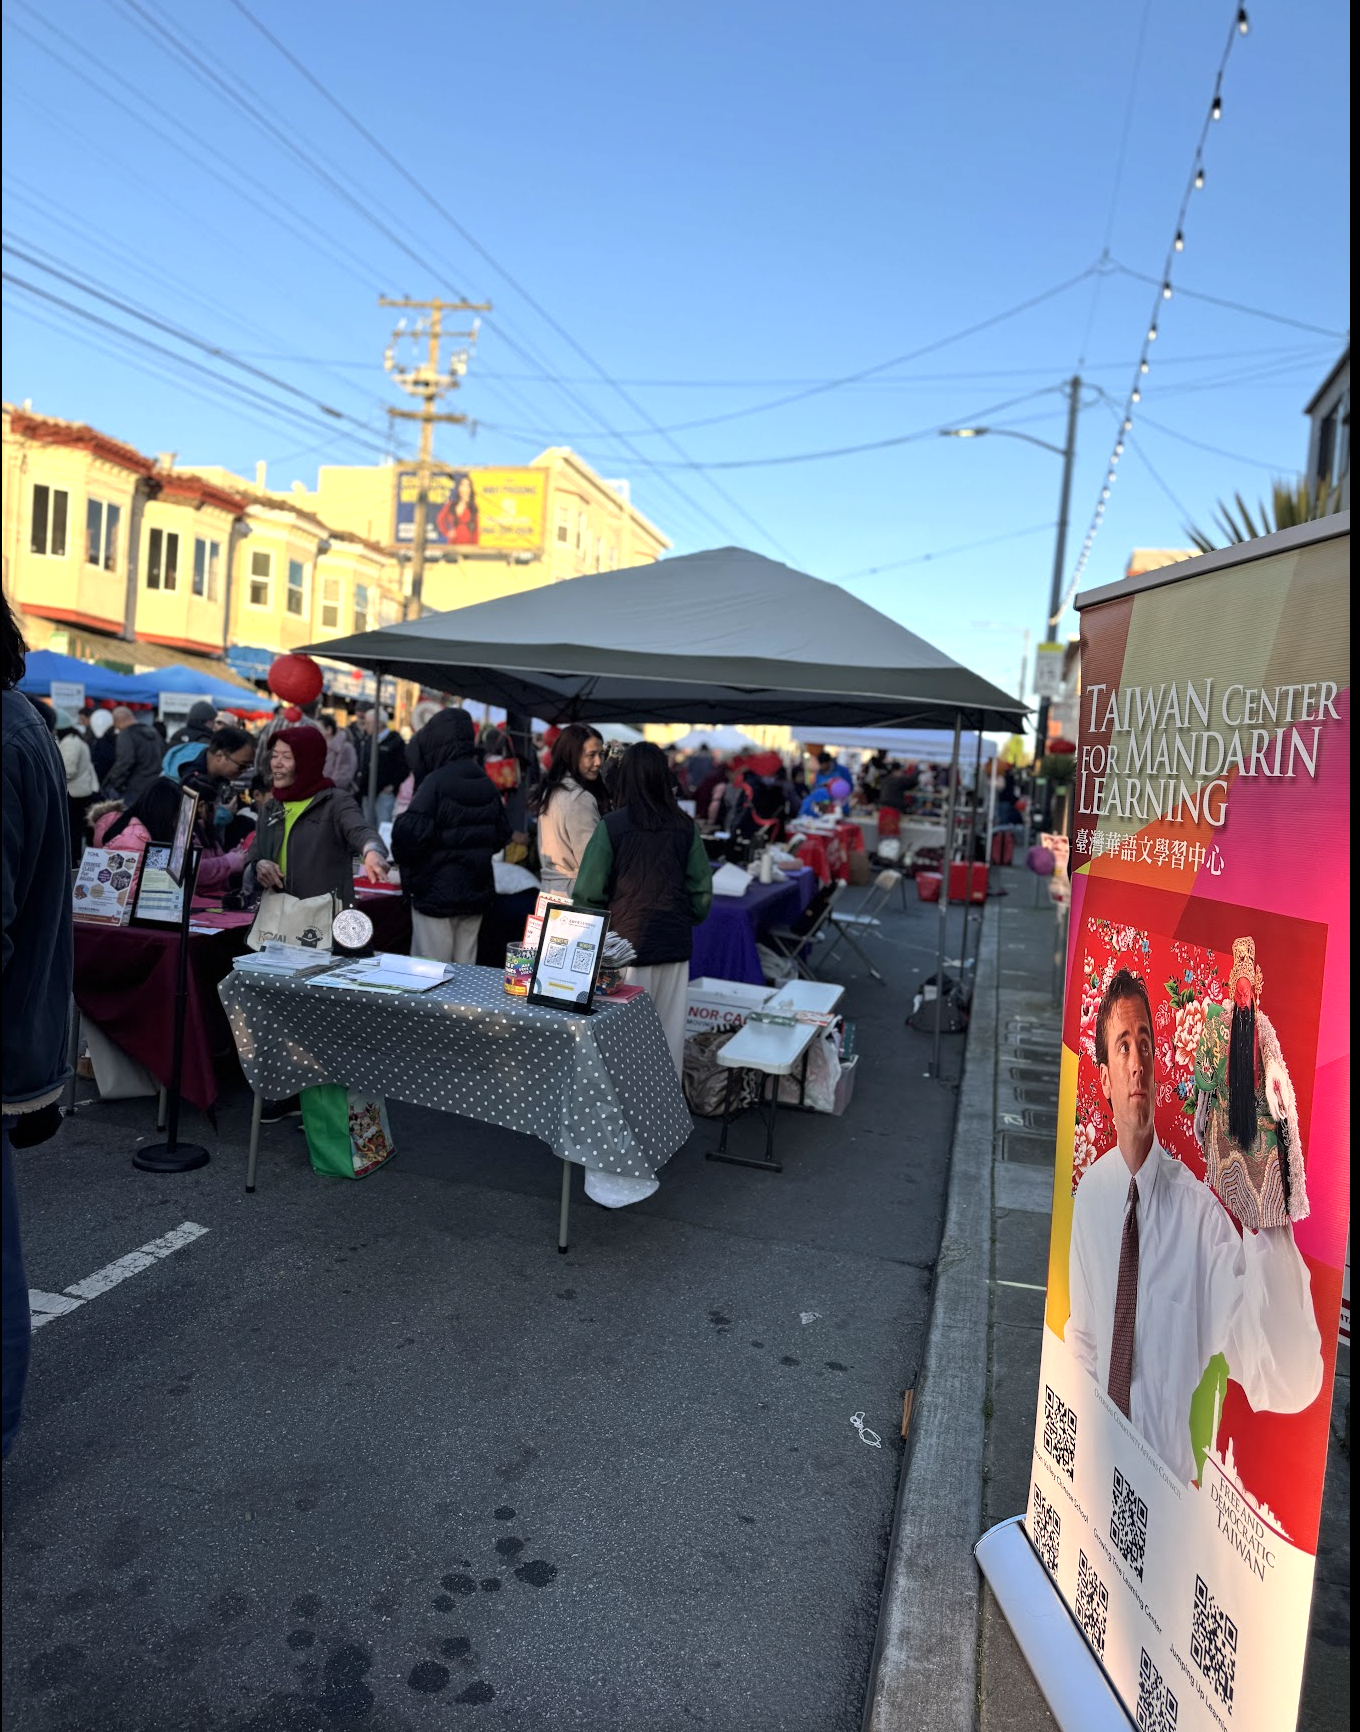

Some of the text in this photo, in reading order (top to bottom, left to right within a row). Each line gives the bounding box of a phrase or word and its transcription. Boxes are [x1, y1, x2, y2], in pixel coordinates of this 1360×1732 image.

[1086, 678, 1341, 733] TAIWAN CENTER
[1081, 726, 1322, 778] FOR MANDARIN
[1078, 771, 1228, 827] LEARNING
[1075, 828, 1225, 876] 臺灣華語文學習中心
[1210, 1482, 1276, 1569] DEMOCRATIC
[1219, 1476, 1264, 1539] FREE AND
[1215, 1505, 1266, 1583] TAIWAN
[1093, 1527, 1112, 1562] Growing
[1122, 1571, 1144, 1611] Learning
[1144, 1604, 1162, 1635] Center
[1169, 1643, 1195, 1687] Jumping
[1195, 1680, 1205, 1700] Up
